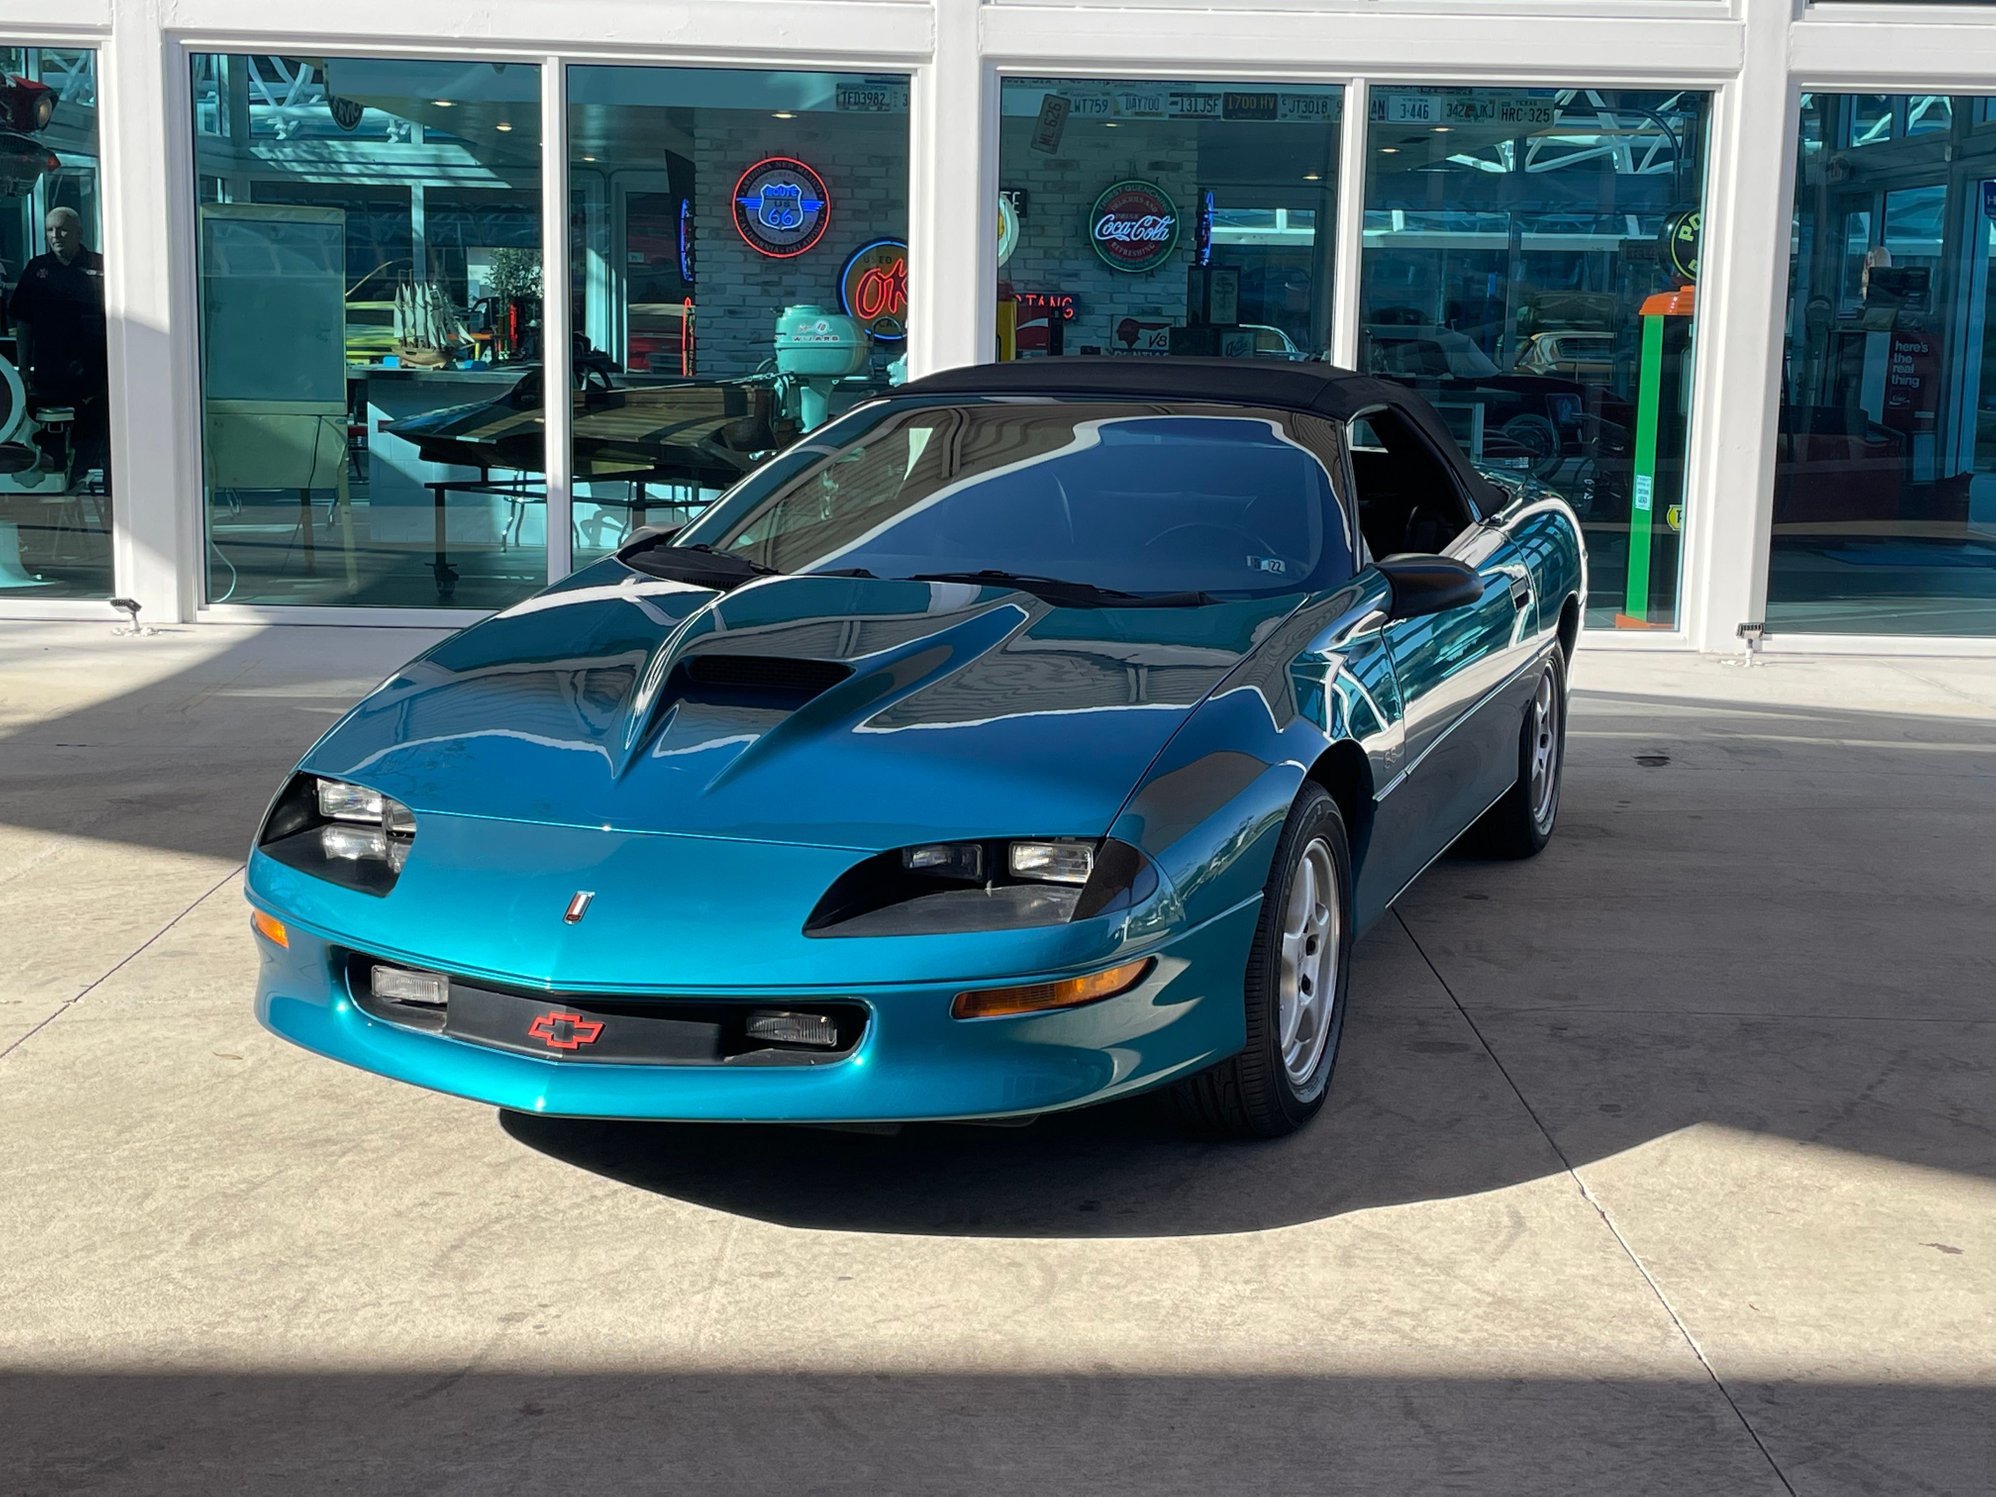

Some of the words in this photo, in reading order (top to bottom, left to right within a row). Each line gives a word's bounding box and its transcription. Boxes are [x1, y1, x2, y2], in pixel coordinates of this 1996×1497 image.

[1068, 98, 1109, 113] WT759
[766, 187, 798, 197] ROUTE
[768, 208, 794, 225] 66
[1094, 213, 1175, 241] Coca-Cola
[855, 258, 908, 319] OK
[1895, 340, 1929, 353] here's
[1893, 353, 1913, 364] the
[1892, 364, 1915, 374] real
[1891, 375, 1920, 388] thing
[1271, 560, 1282, 573] 22
